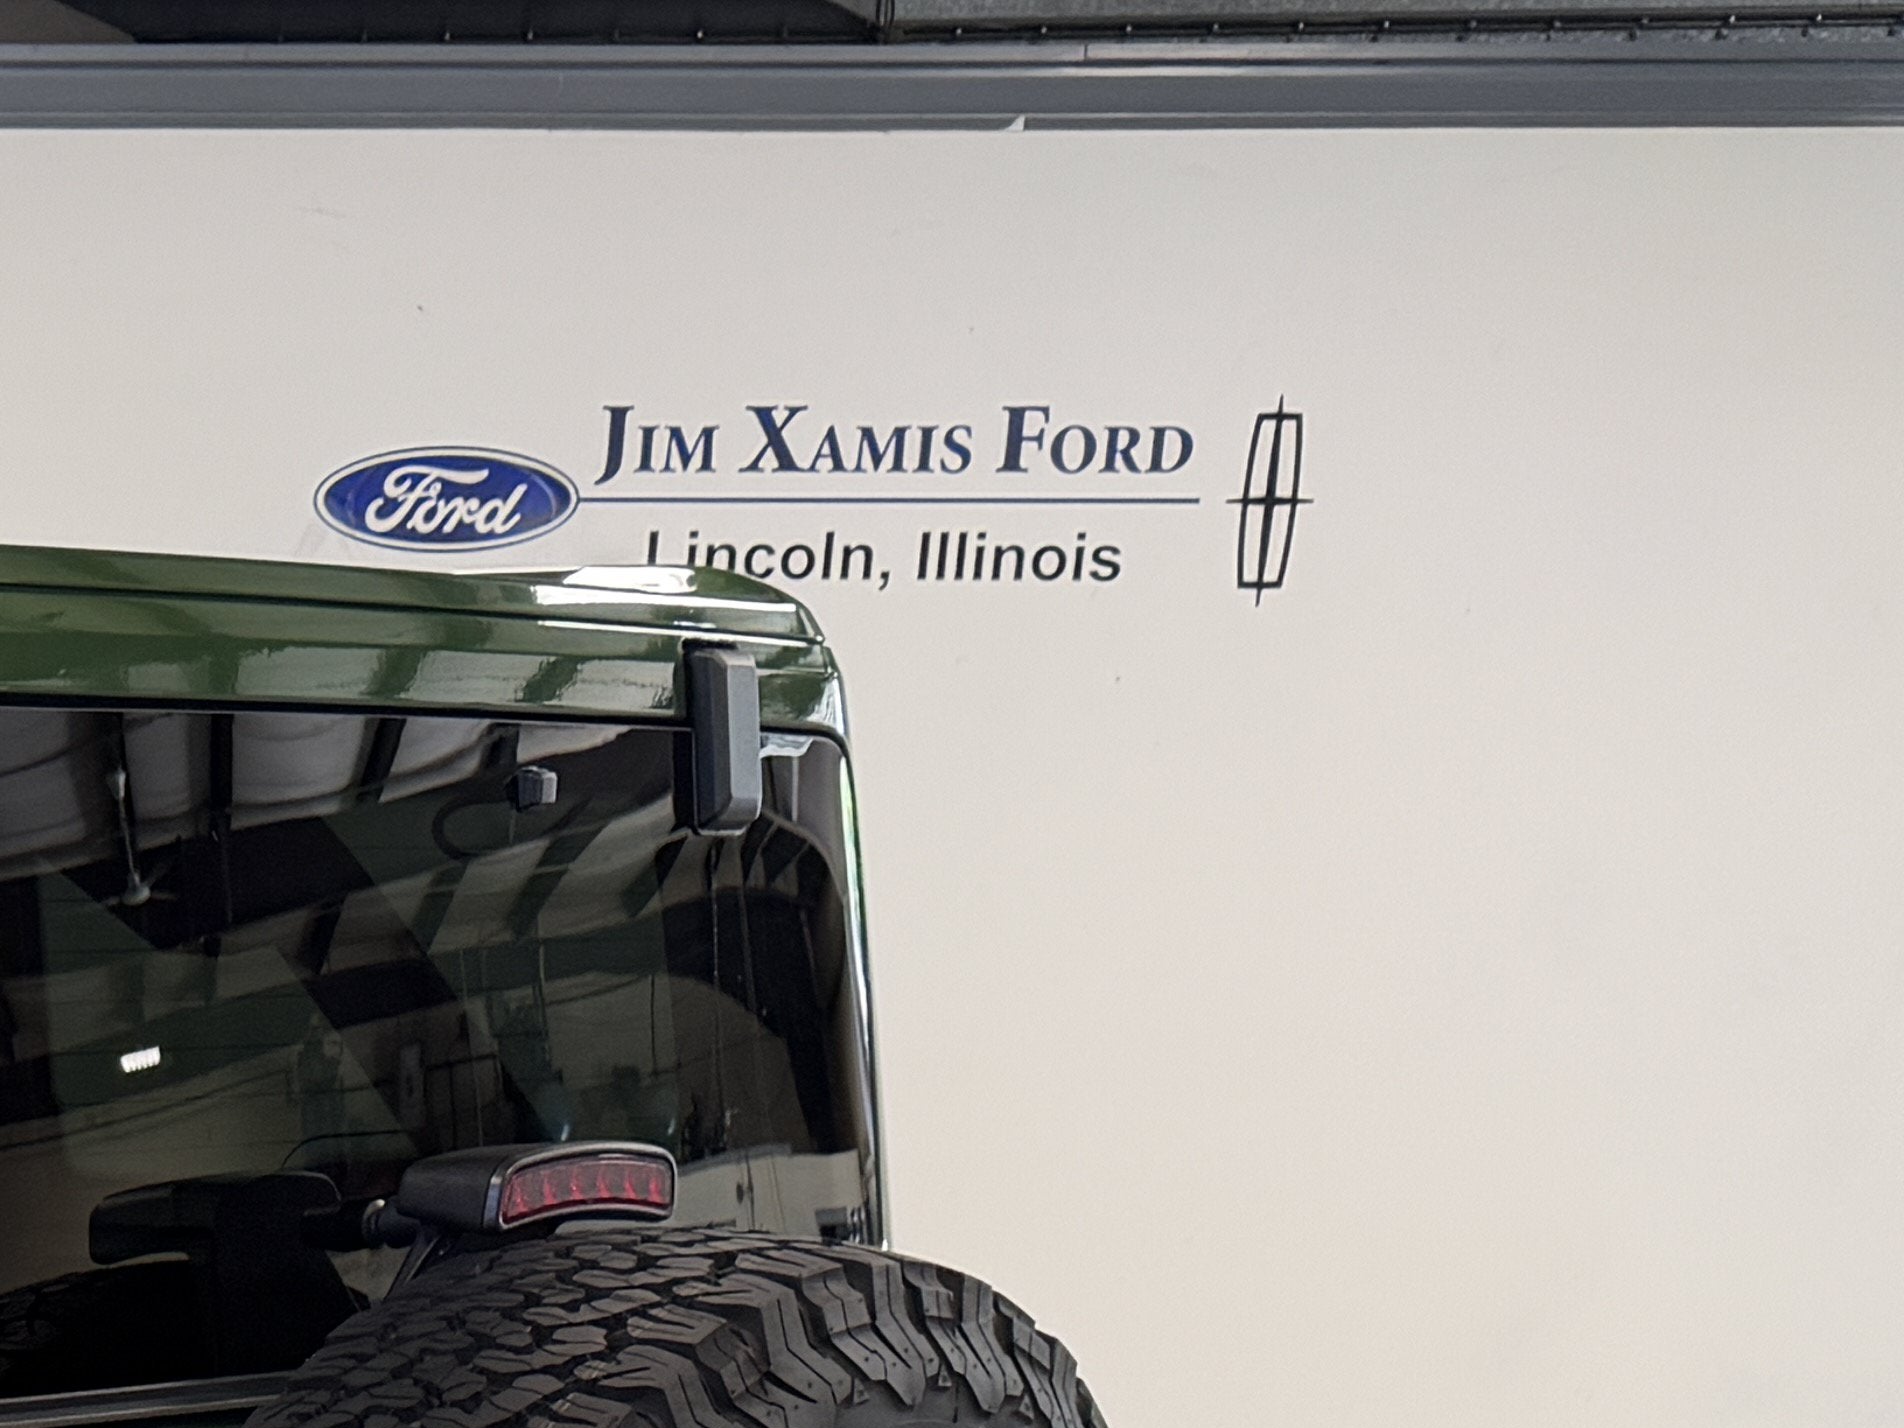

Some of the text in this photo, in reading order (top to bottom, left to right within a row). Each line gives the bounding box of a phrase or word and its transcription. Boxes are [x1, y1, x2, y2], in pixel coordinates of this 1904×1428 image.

[739, 404, 973, 476] XAMIS
[994, 405, 1196, 478] FORD
[363, 464, 525, 538] Ford
[916, 530, 1123, 583] Illinois
